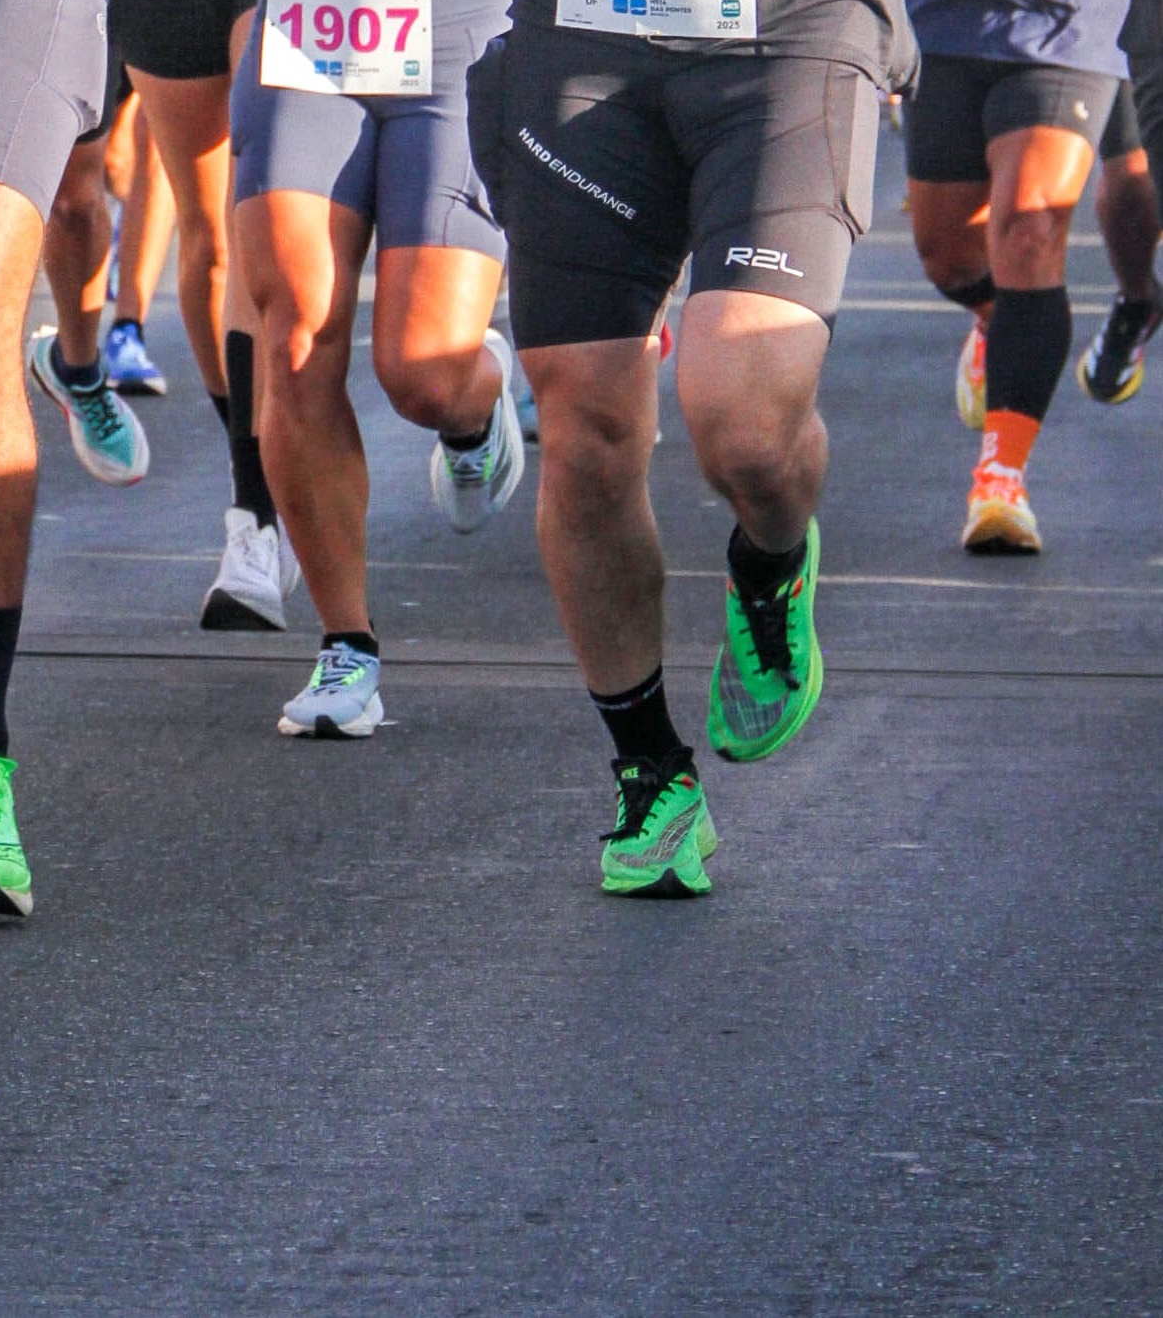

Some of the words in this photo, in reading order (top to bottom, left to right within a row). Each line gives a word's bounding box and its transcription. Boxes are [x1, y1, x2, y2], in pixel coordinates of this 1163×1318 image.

[280, 2, 420, 54] 1907
[717, 21, 740, 30] 2025
[724, 247, 805, 278] R2L
